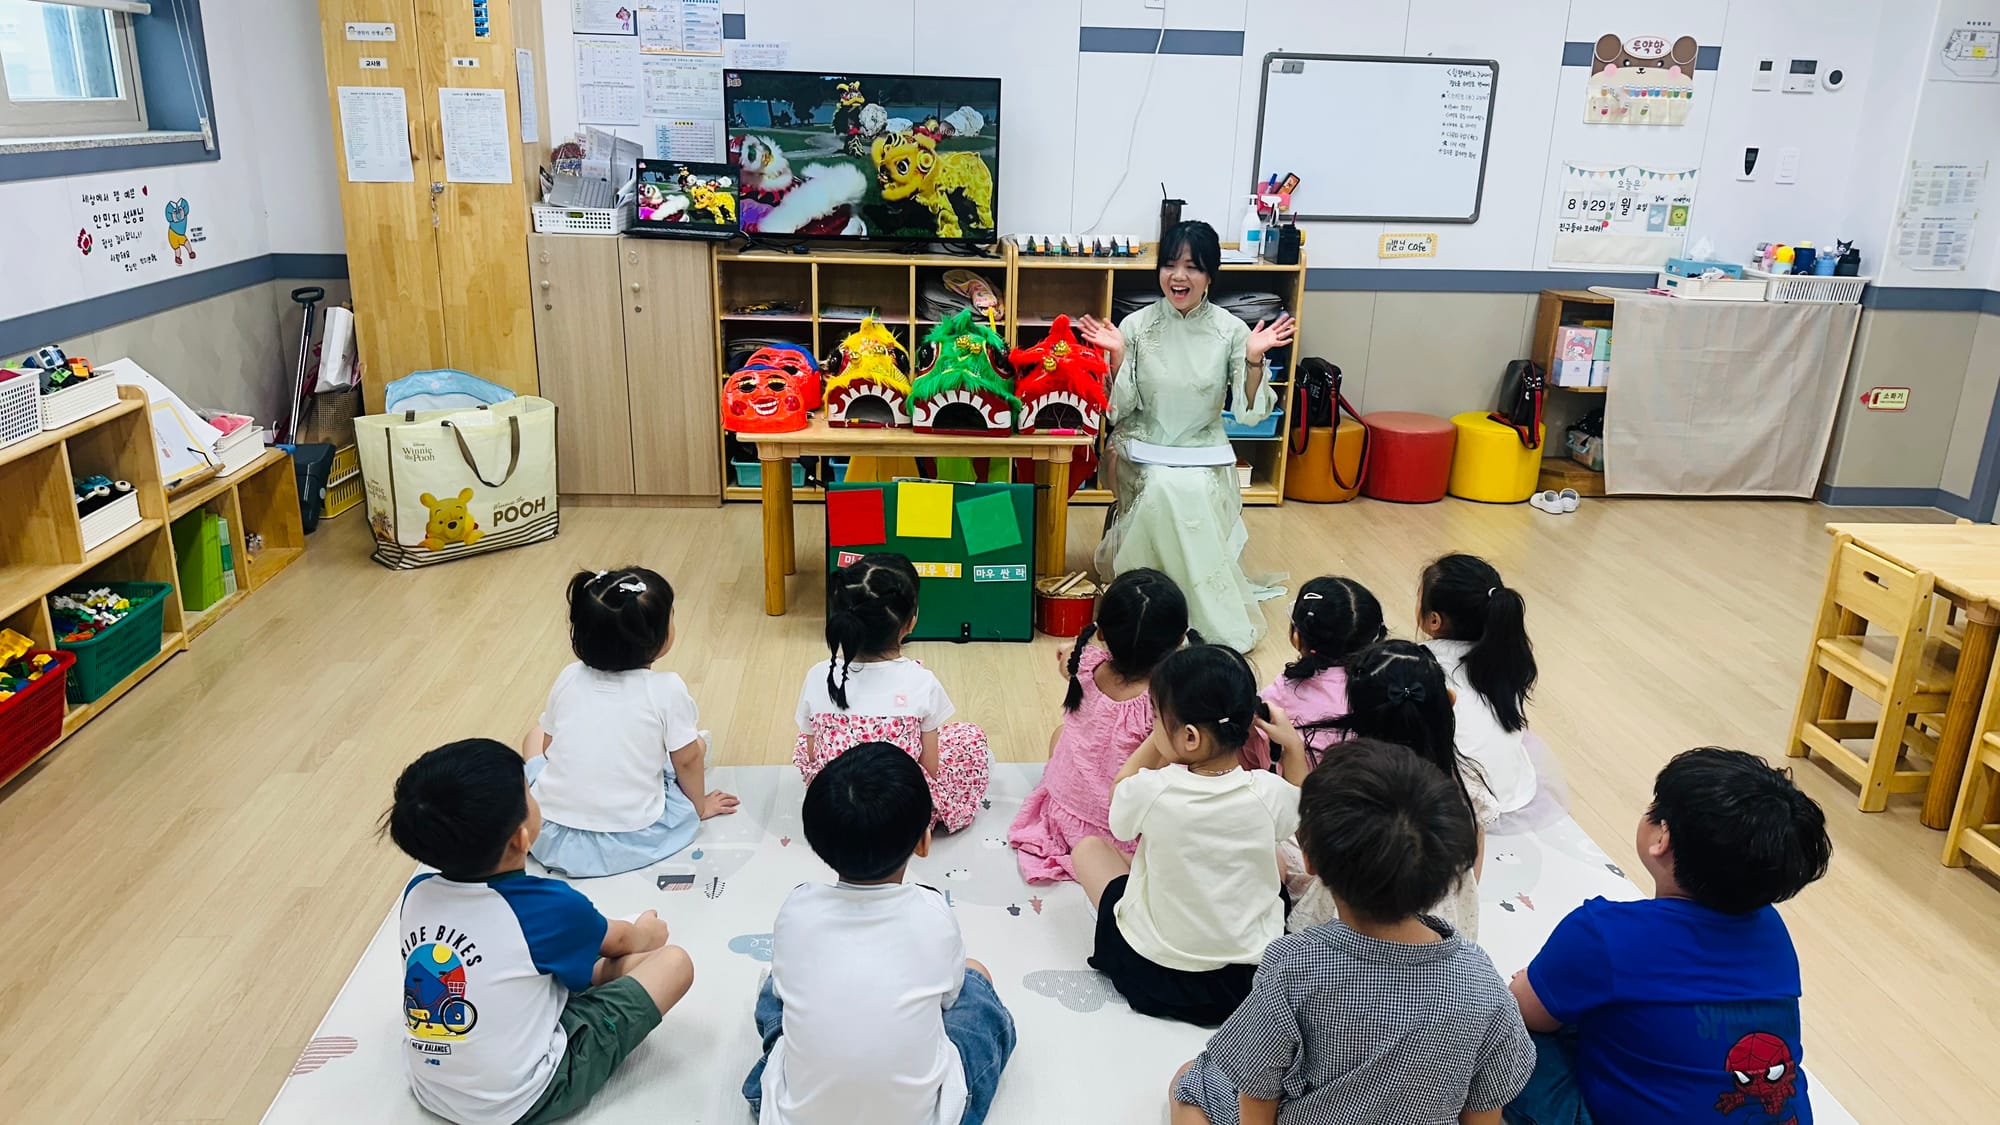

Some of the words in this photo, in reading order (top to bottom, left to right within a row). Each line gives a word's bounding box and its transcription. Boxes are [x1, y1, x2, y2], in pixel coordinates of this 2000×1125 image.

[82, 193, 109, 206] 세상에서
[1567, 198, 1577, 210] 8
[1590, 199, 1606, 211] 29
[1609, 201, 1616, 211] 일
[1621, 197, 1632, 216] 월
[1636, 203, 1648, 212] 요일
[93, 212, 120, 229] 안민지
[122, 207, 145, 224] 선생님
[1559, 222, 1582, 233] 친구들아
[1883, 392, 1904, 400] 소화기
[402, 447, 433, 455] Winnie
[413, 453, 435, 462] Pooh
[493, 496, 546, 528] POOH
[976, 568, 995, 579] 마우
[401, 926, 426, 961] RIDE
[435, 925, 482, 967] BIKES
[411, 1041, 424, 1051] NEW
[424, 1043, 449, 1053] BALANCE
